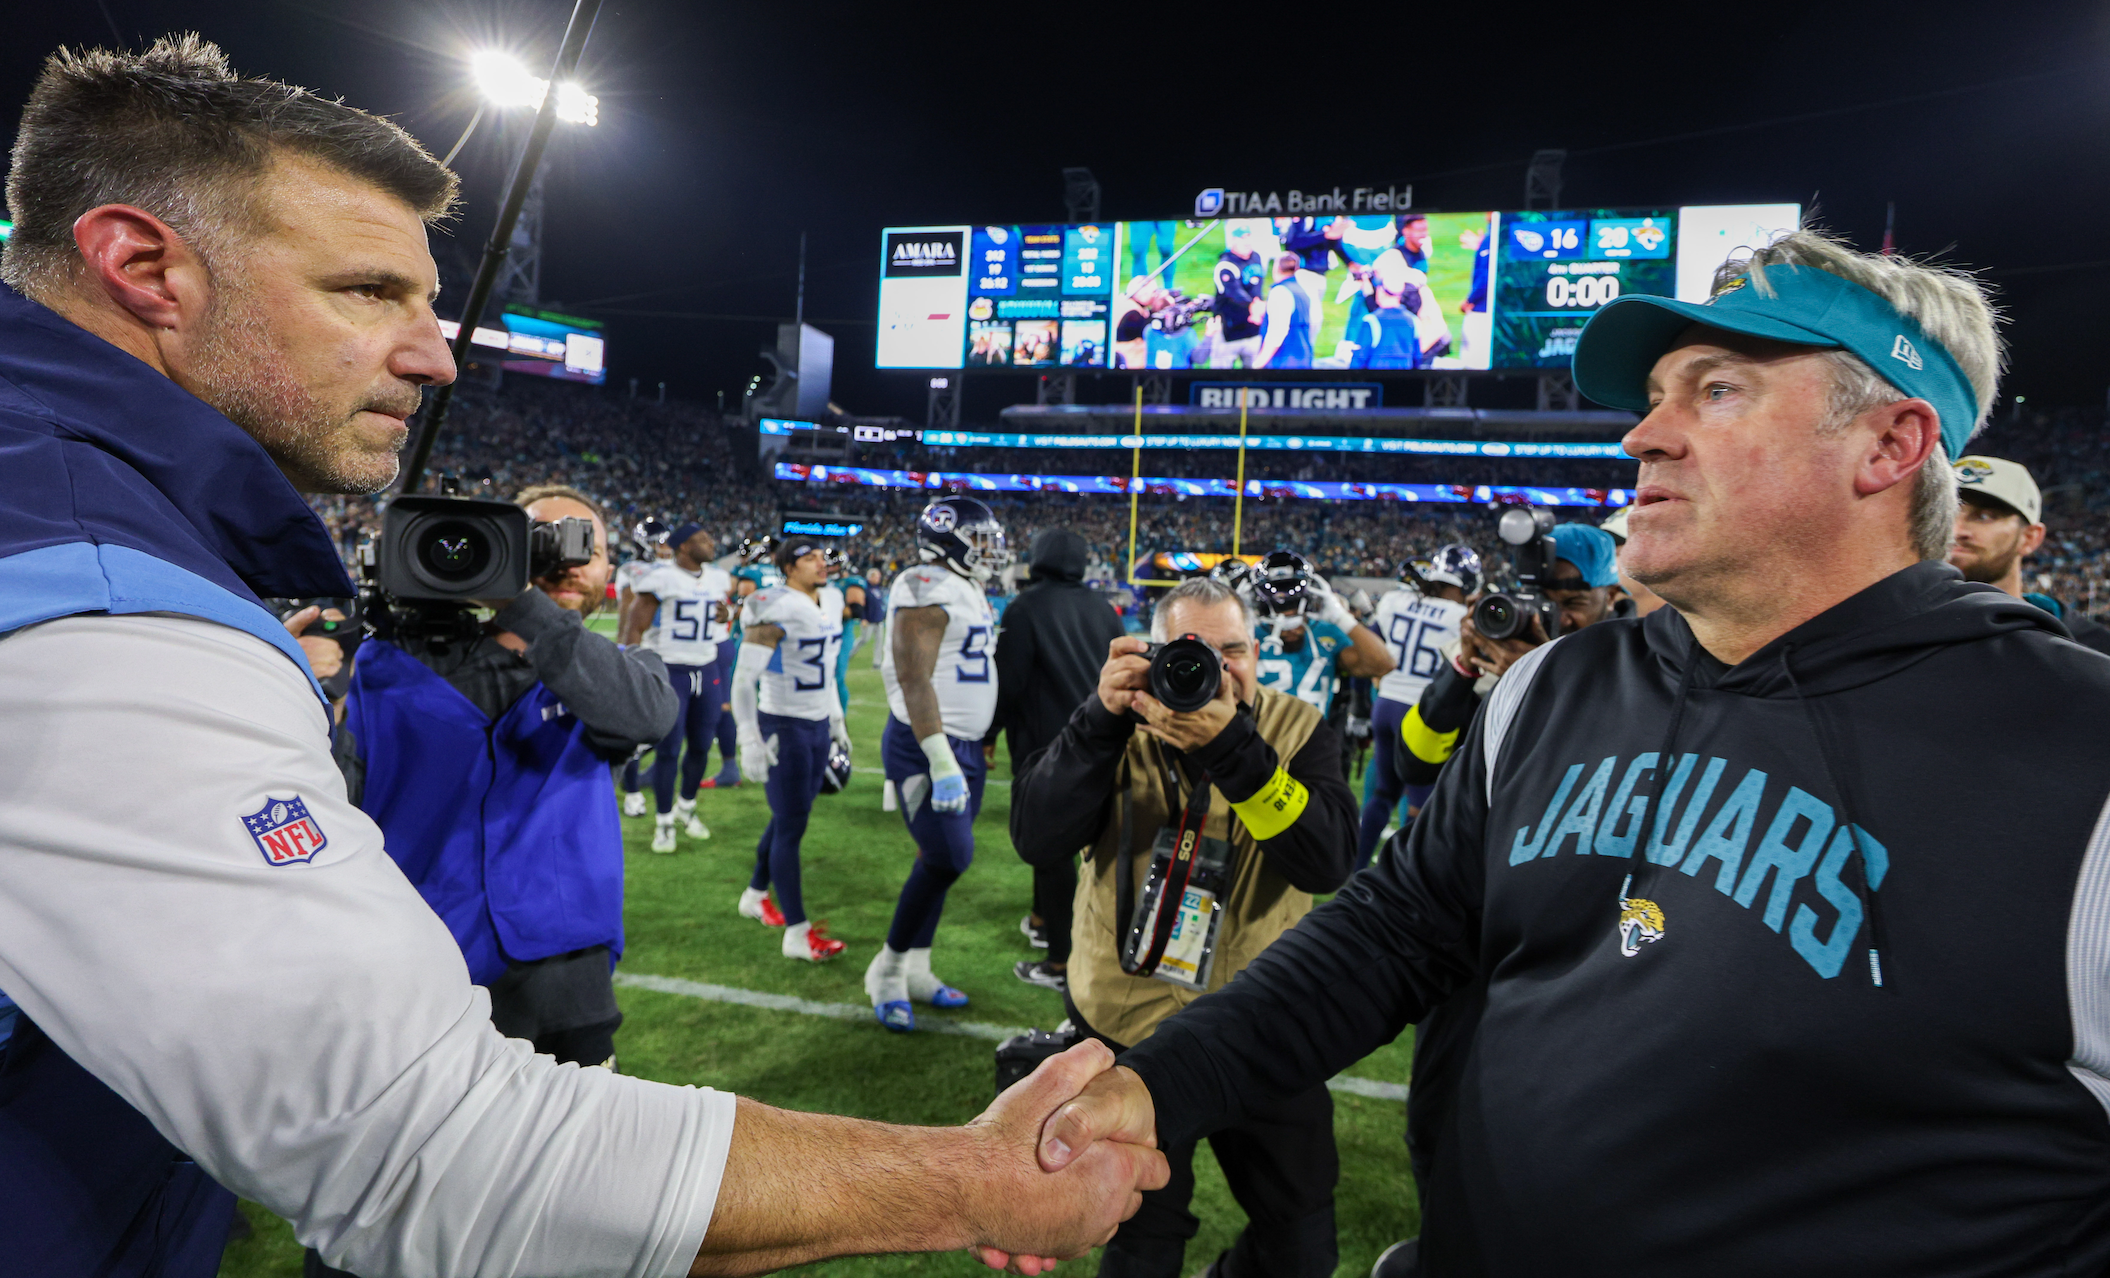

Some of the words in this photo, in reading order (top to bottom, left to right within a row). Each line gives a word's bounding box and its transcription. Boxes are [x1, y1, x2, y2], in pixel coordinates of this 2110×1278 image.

[1224, 191, 1283, 214] TIAA
[1287, 187, 1348, 213] Bank
[1352, 184, 1413, 212] Field
[892, 242, 957, 260] AMARA
[1551, 228, 1579, 250] 16
[1597, 226, 1629, 249] 20
[1546, 276, 1620, 308] 0:00
[1200, 388, 1270, 409] BUD
[1273, 388, 1372, 409] LIGHT
[1390, 613, 1447, 679] 96
[1256, 657, 1329, 714] 24
[1273, 798, 1287, 812] 18
[262, 820, 323, 861] NFL
[1178, 828, 1196, 862] EOS
[1508, 751, 1890, 980] JAGUARS
